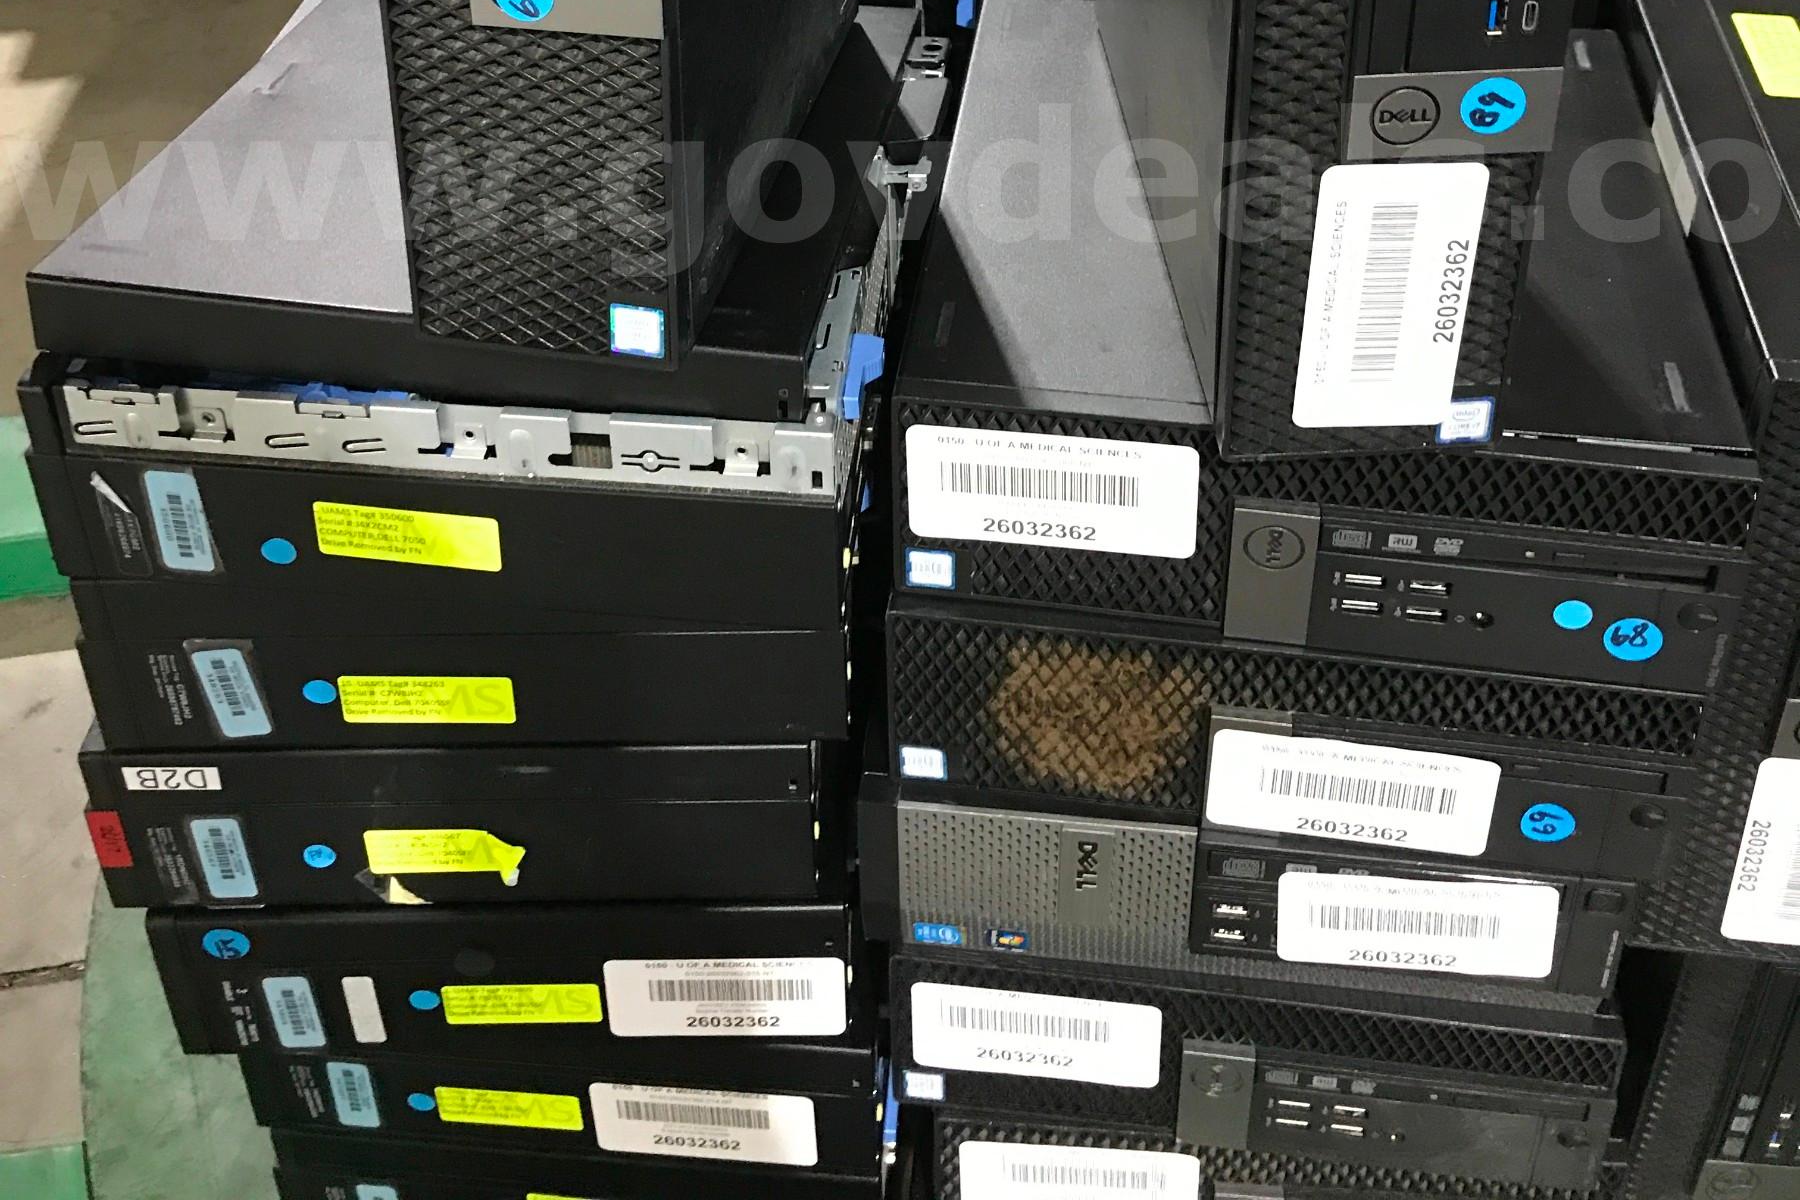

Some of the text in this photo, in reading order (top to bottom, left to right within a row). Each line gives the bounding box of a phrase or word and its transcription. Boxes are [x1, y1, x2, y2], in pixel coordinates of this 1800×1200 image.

[1379, 106, 1433, 126] DELL
[1432, 239, 1470, 344] 26032362
[1019, 442, 1072, 454] MEDICAL
[1079, 447, 1142, 459] SCIENCES
[983, 516, 1097, 542] 26032362
[1264, 529, 1285, 564] DELL
[1610, 622, 1650, 648] 68
[136, 769, 208, 789] D2B
[1295, 816, 1408, 843] 26032362
[1075, 841, 1099, 892] DELL
[1736, 819, 1772, 893] 26032362
[1348, 948, 1458, 968] 26032362
[686, 1015, 781, 1028] 26032362
[976, 1046, 1074, 1068] 26032362
[653, 1133, 742, 1152] 26032362
